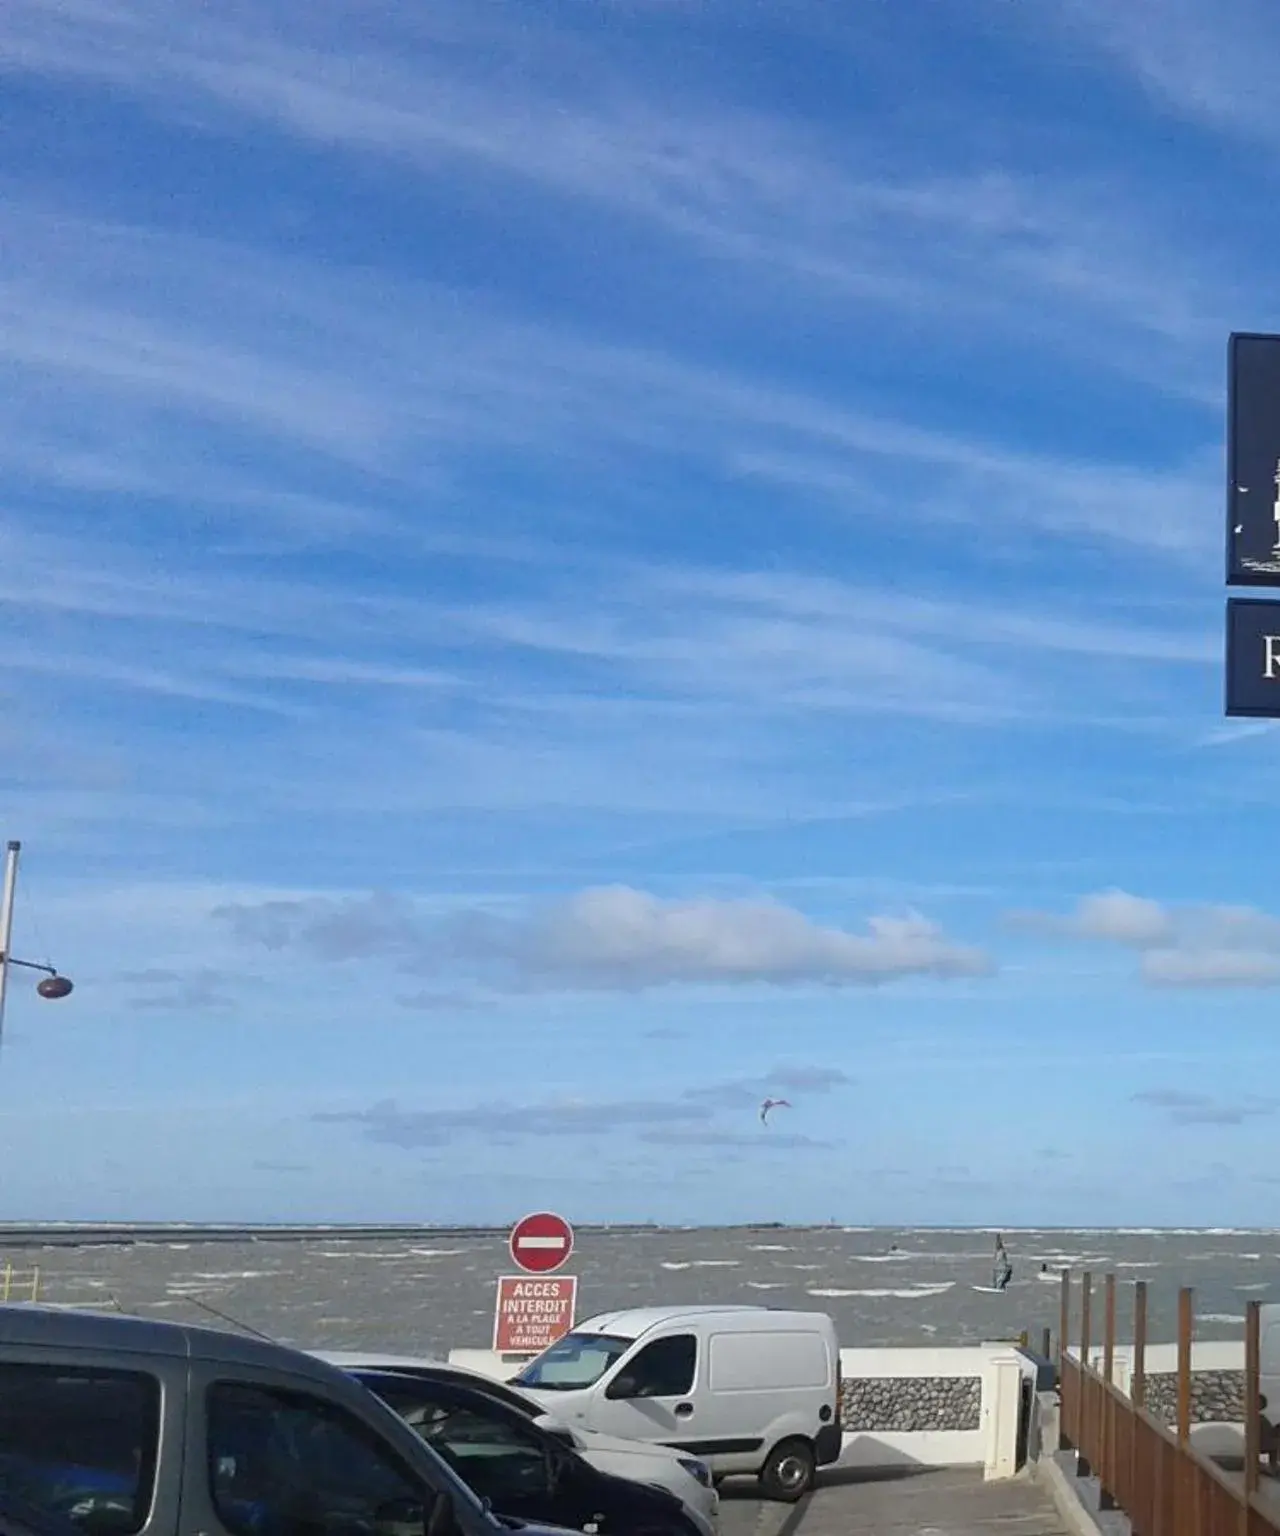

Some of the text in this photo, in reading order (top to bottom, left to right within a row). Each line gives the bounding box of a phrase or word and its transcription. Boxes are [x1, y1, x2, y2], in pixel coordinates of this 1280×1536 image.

[513, 1283, 560, 1297] ACCES
[503, 1300, 568, 1312] INTERDIT
[507, 1314, 561, 1323] A LA PLAGE
[516, 1325, 551, 1334] A TOUT
